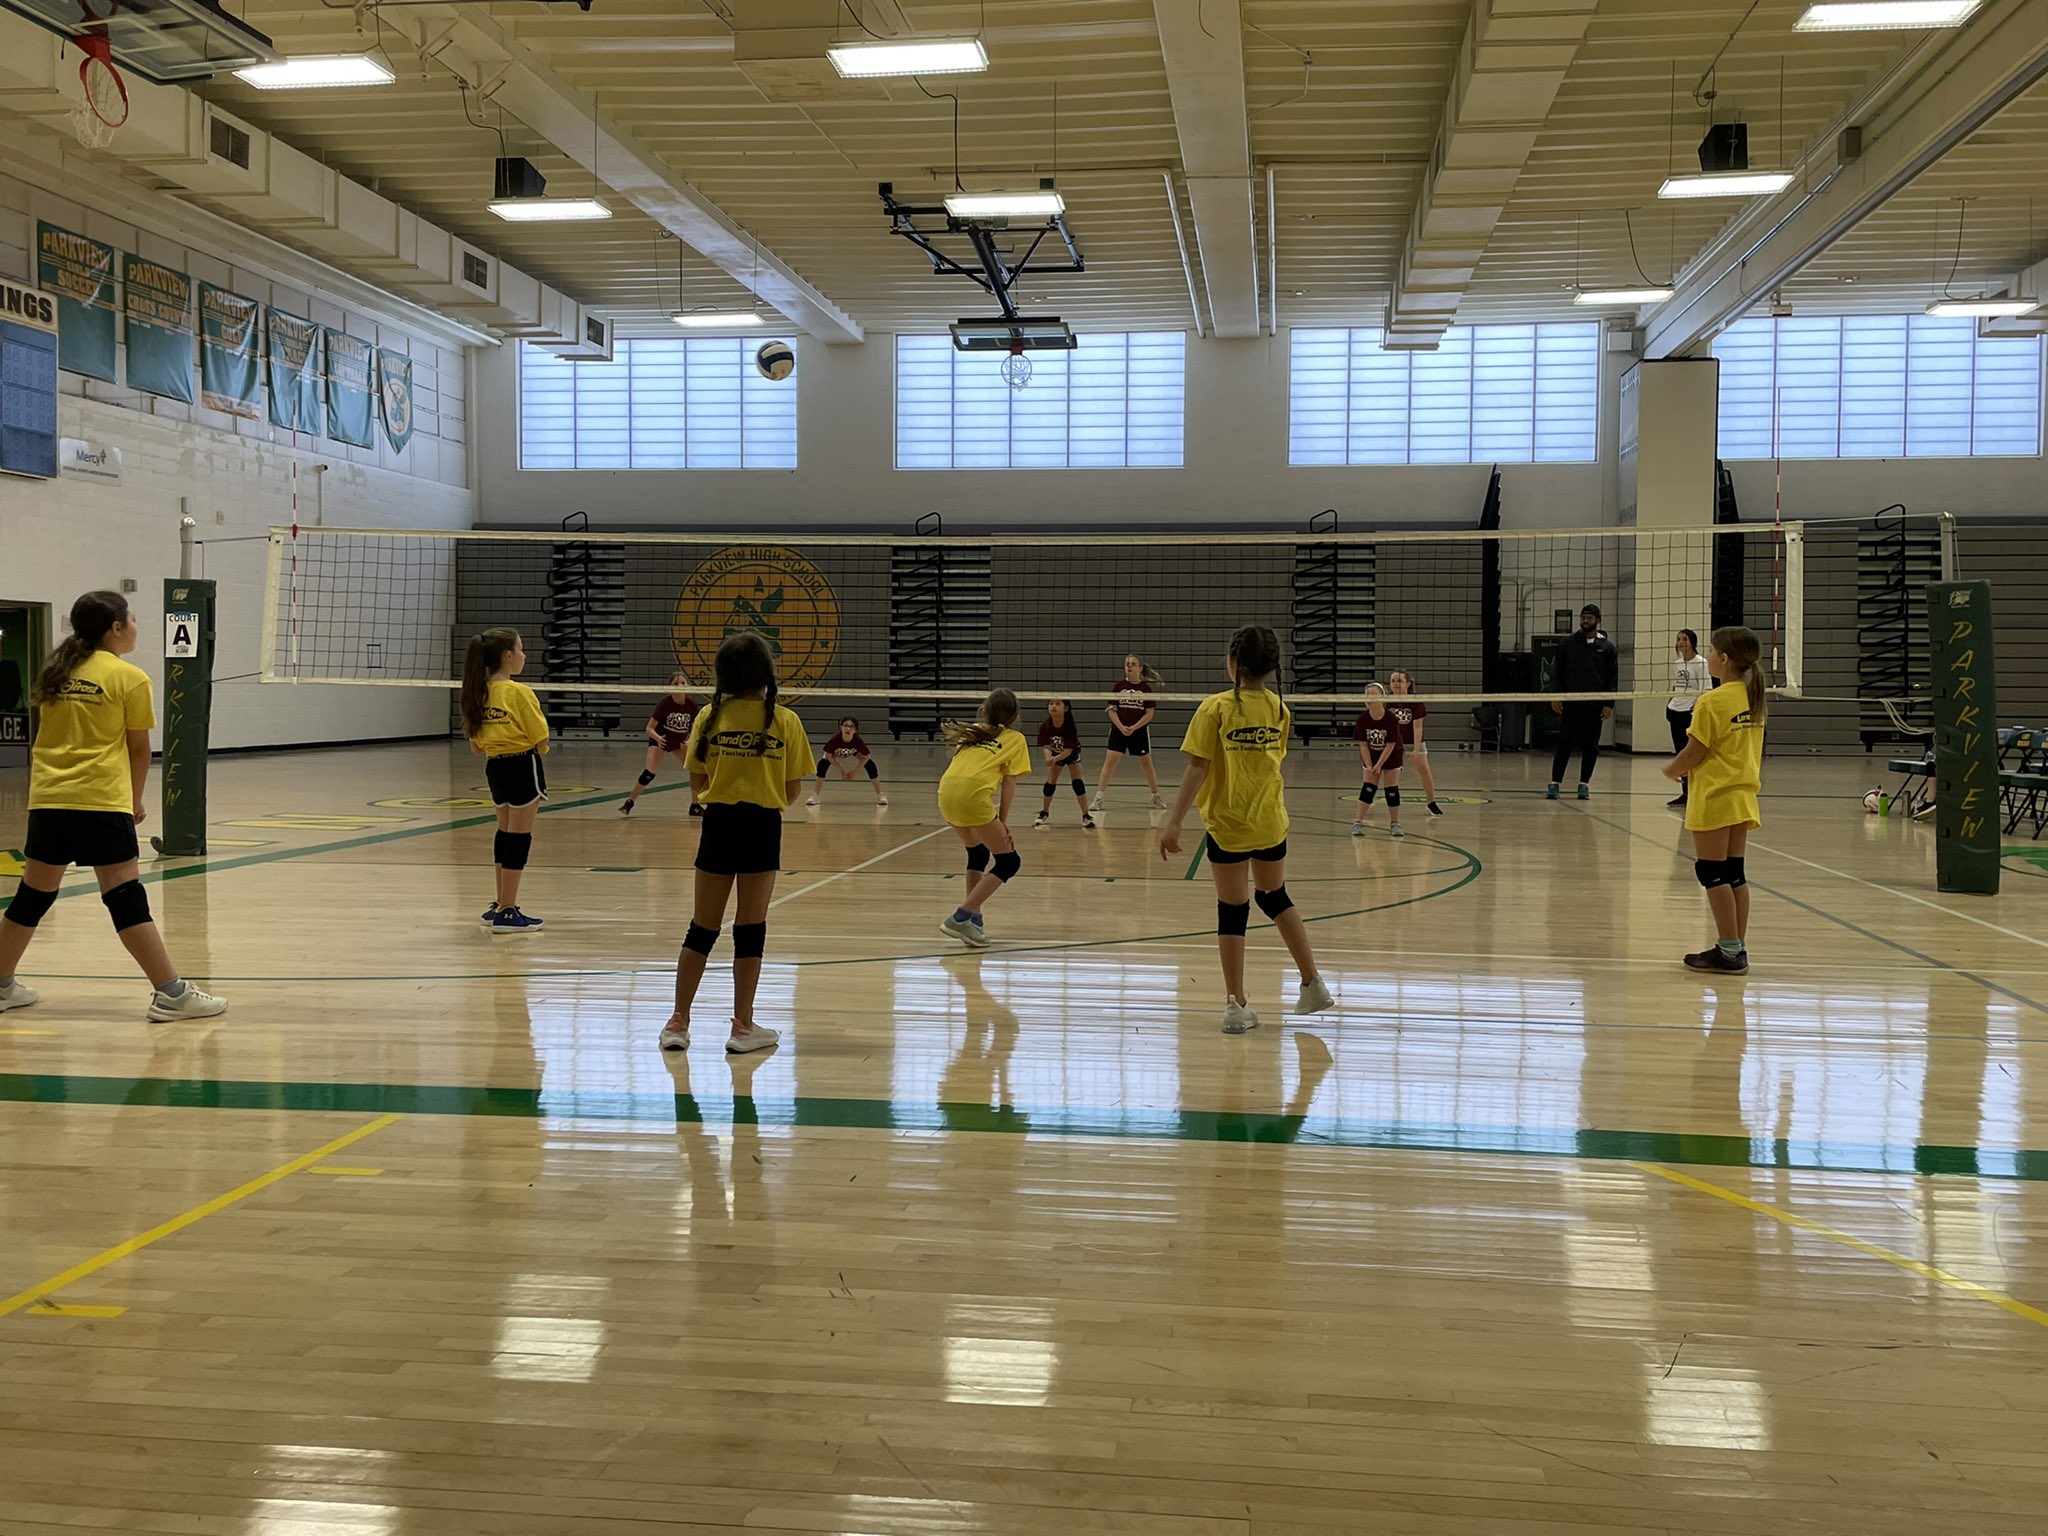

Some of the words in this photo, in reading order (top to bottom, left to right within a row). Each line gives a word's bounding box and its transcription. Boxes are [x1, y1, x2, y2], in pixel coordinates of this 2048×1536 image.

[42, 232, 110, 271] PARKVIEW
[128, 263, 190, 297] PARKVIEW
[128, 294, 156, 316] CROSS
[76, 449, 100, 467] Mercy
[690, 550, 746, 597] PARKVIEW
[750, 548, 781, 565] HIGH
[782, 555, 826, 598] SCHOOL
[168, 614, 197, 623] COURT
[172, 624, 192, 646] A
[1949, 620, 1985, 840] PARKVIEW
